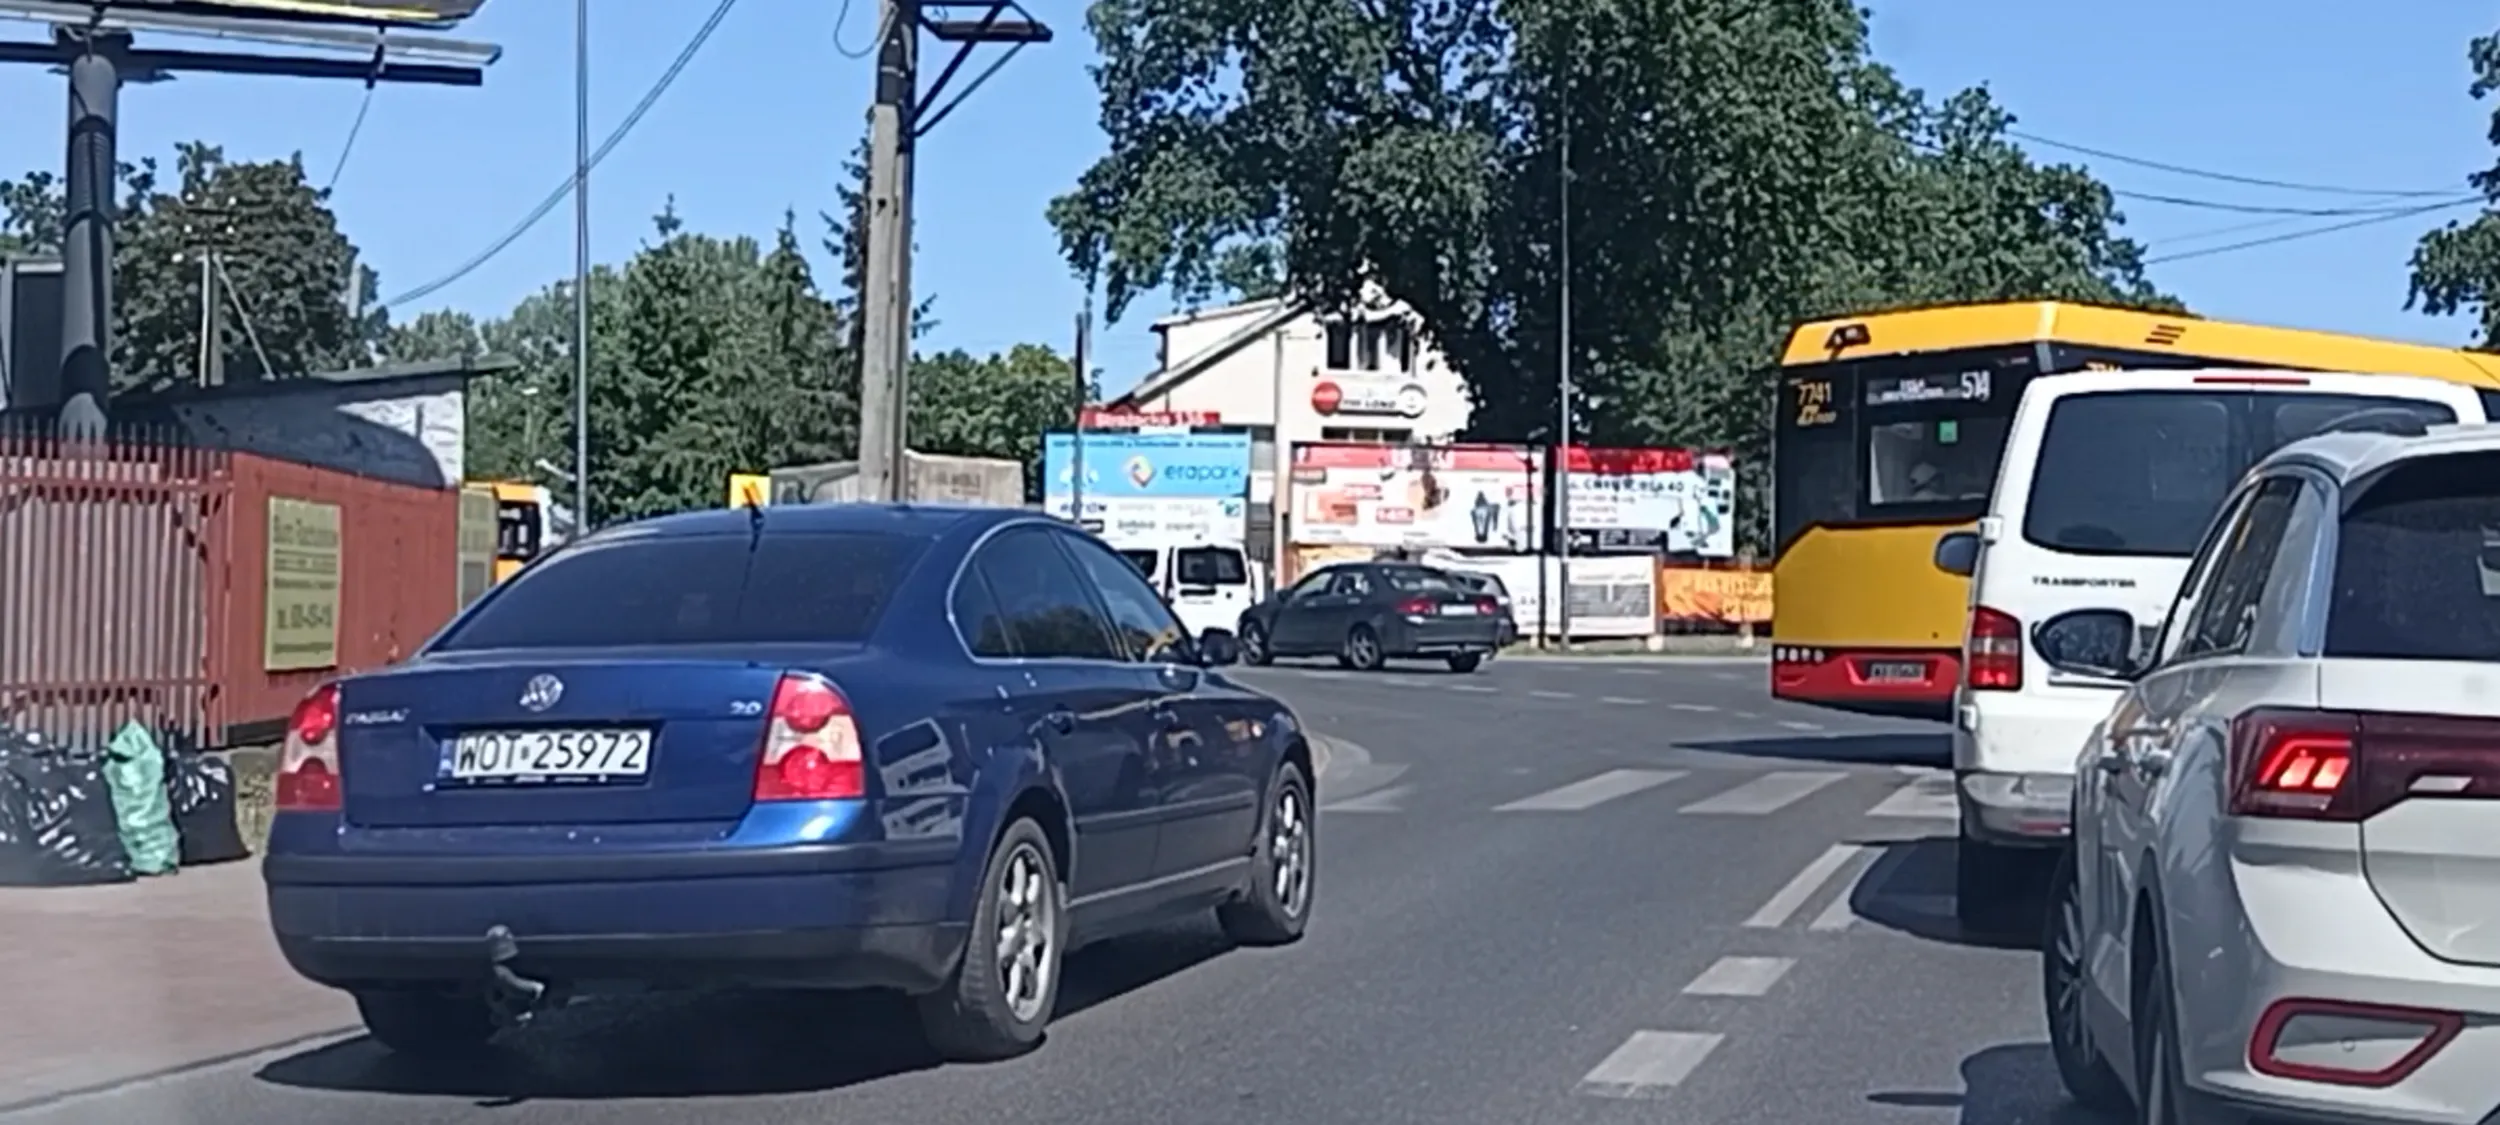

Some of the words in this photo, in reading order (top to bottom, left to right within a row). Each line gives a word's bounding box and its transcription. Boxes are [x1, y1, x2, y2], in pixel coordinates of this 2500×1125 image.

[1798, 381, 1832, 405] 7741
[1164, 463, 1242, 484] erapark
[2032, 575, 2136, 588] TRANSPORTER
[458, 732, 521, 771] WOT
[532, 732, 643, 771] 25972
